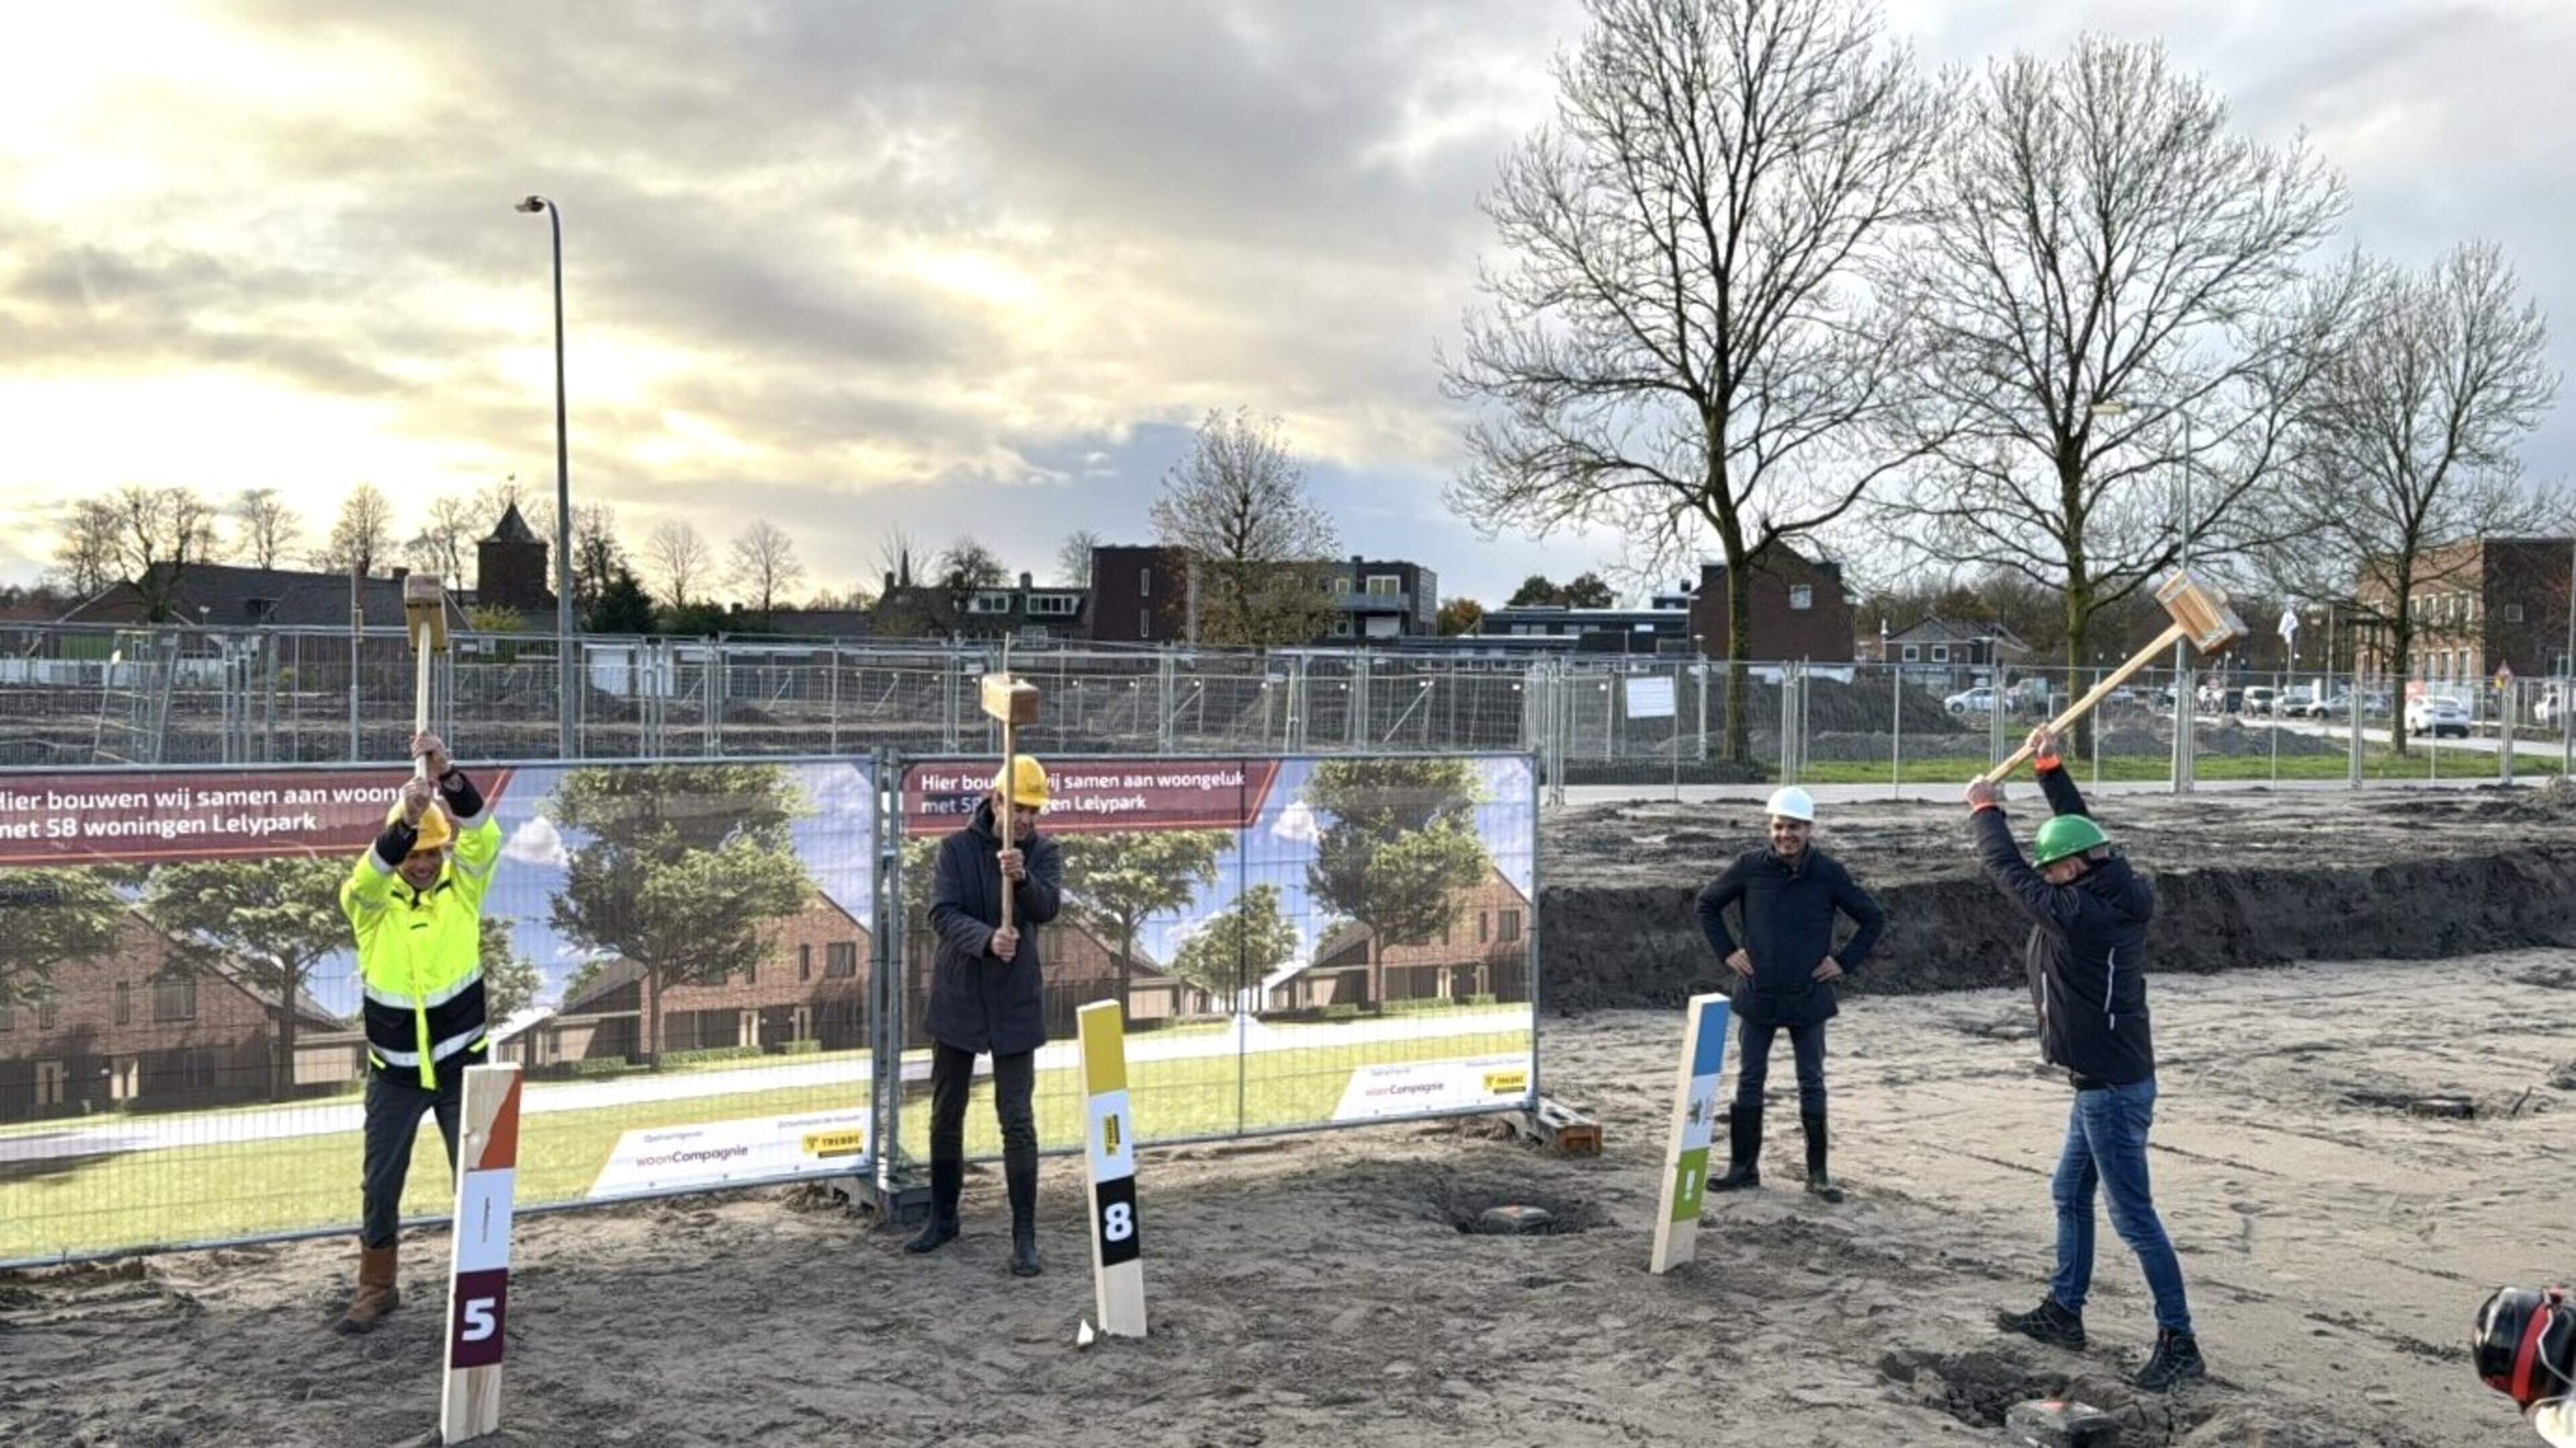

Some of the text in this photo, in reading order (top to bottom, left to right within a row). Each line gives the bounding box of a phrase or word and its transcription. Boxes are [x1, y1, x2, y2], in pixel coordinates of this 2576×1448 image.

[922, 774, 958, 790] Hier
[962, 774, 995, 790] bou
[1064, 775, 1120, 789] samen
[1124, 774, 1153, 787] aan
[1157, 771, 1244, 791] woongeluk
[48, 790, 148, 810] bouwen
[155, 788, 190, 810] wij
[197, 788, 277, 805] samen
[284, 787, 326, 803] aan
[922, 797, 955, 814] met
[1075, 795, 1146, 814] Lelypark
[46, 818, 78, 837] 58
[83, 816, 205, 838] woningen
[213, 814, 317, 836] Lelypark
[636, 1144, 748, 1167] woonCompagnie
[1105, 1201, 1133, 1241] 8
[462, 1297, 496, 1341] 5
